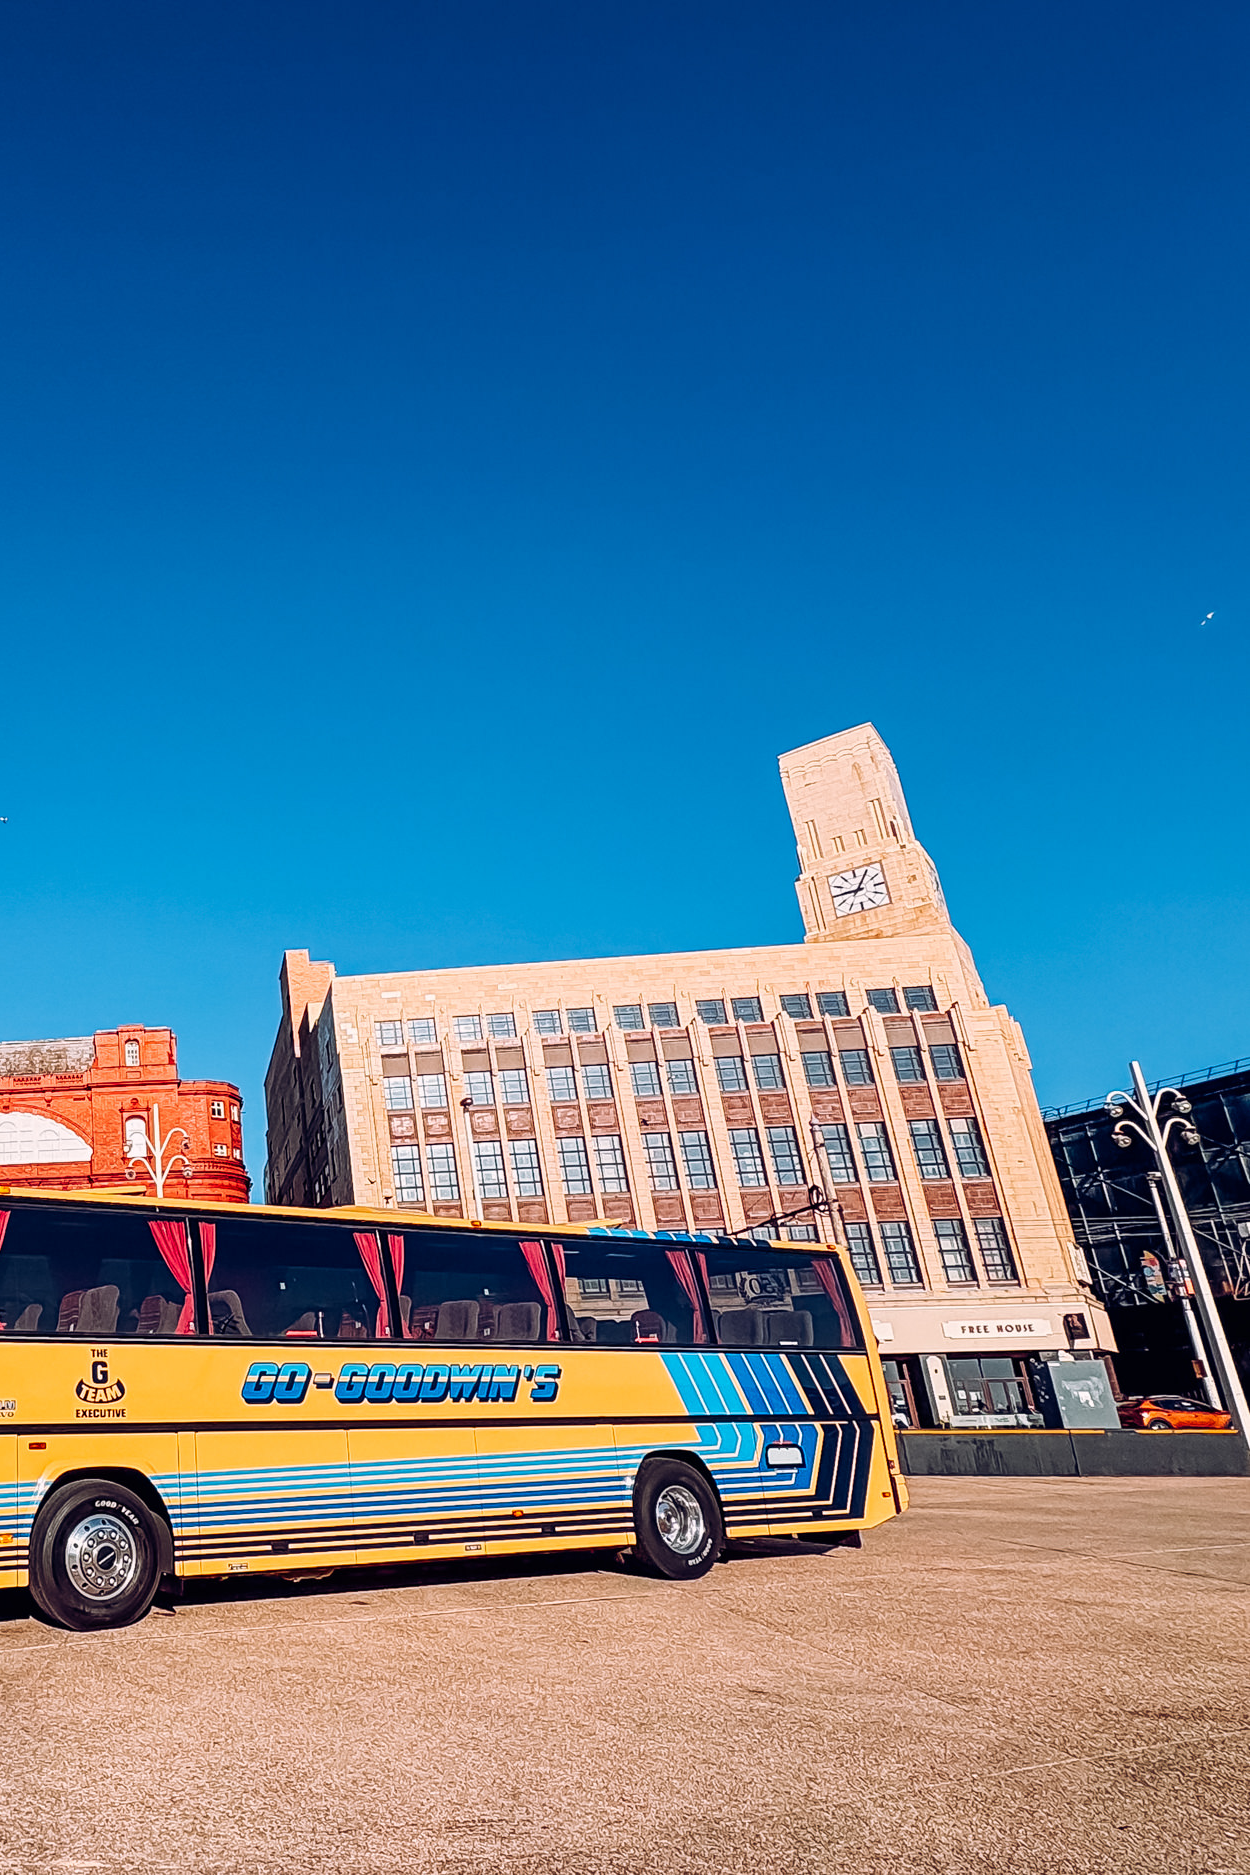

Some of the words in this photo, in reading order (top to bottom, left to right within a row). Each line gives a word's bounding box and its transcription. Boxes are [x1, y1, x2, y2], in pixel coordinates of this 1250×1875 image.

[960, 1325, 990, 1334] FREE
[996, 1323, 1035, 1333] HOUSE
[90, 1348, 109, 1358] THE
[91, 1360, 109, 1384] G
[78, 1383, 123, 1403] TEAM
[75, 1408, 127, 1418] EXECUTIVE
